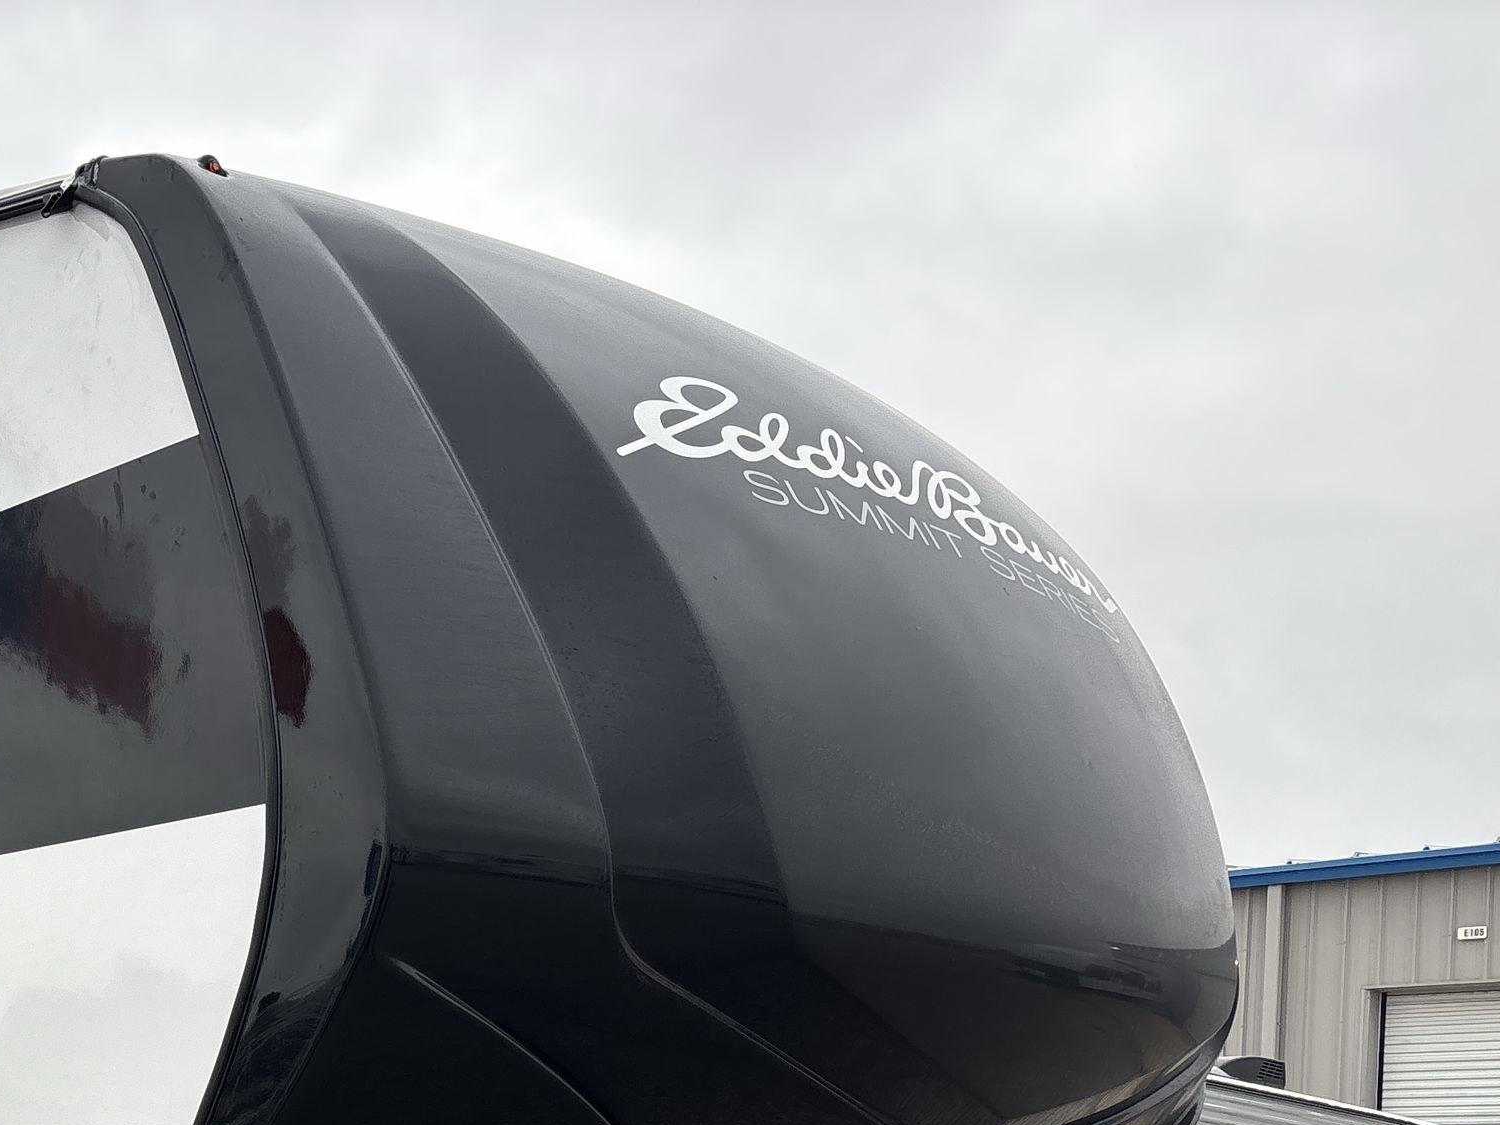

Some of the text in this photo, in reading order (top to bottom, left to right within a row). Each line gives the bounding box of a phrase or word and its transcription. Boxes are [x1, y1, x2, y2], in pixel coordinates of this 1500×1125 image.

[616, 375, 1118, 614] Eddie Bauer
[743, 468, 1120, 644] SUMMIT SERIES
